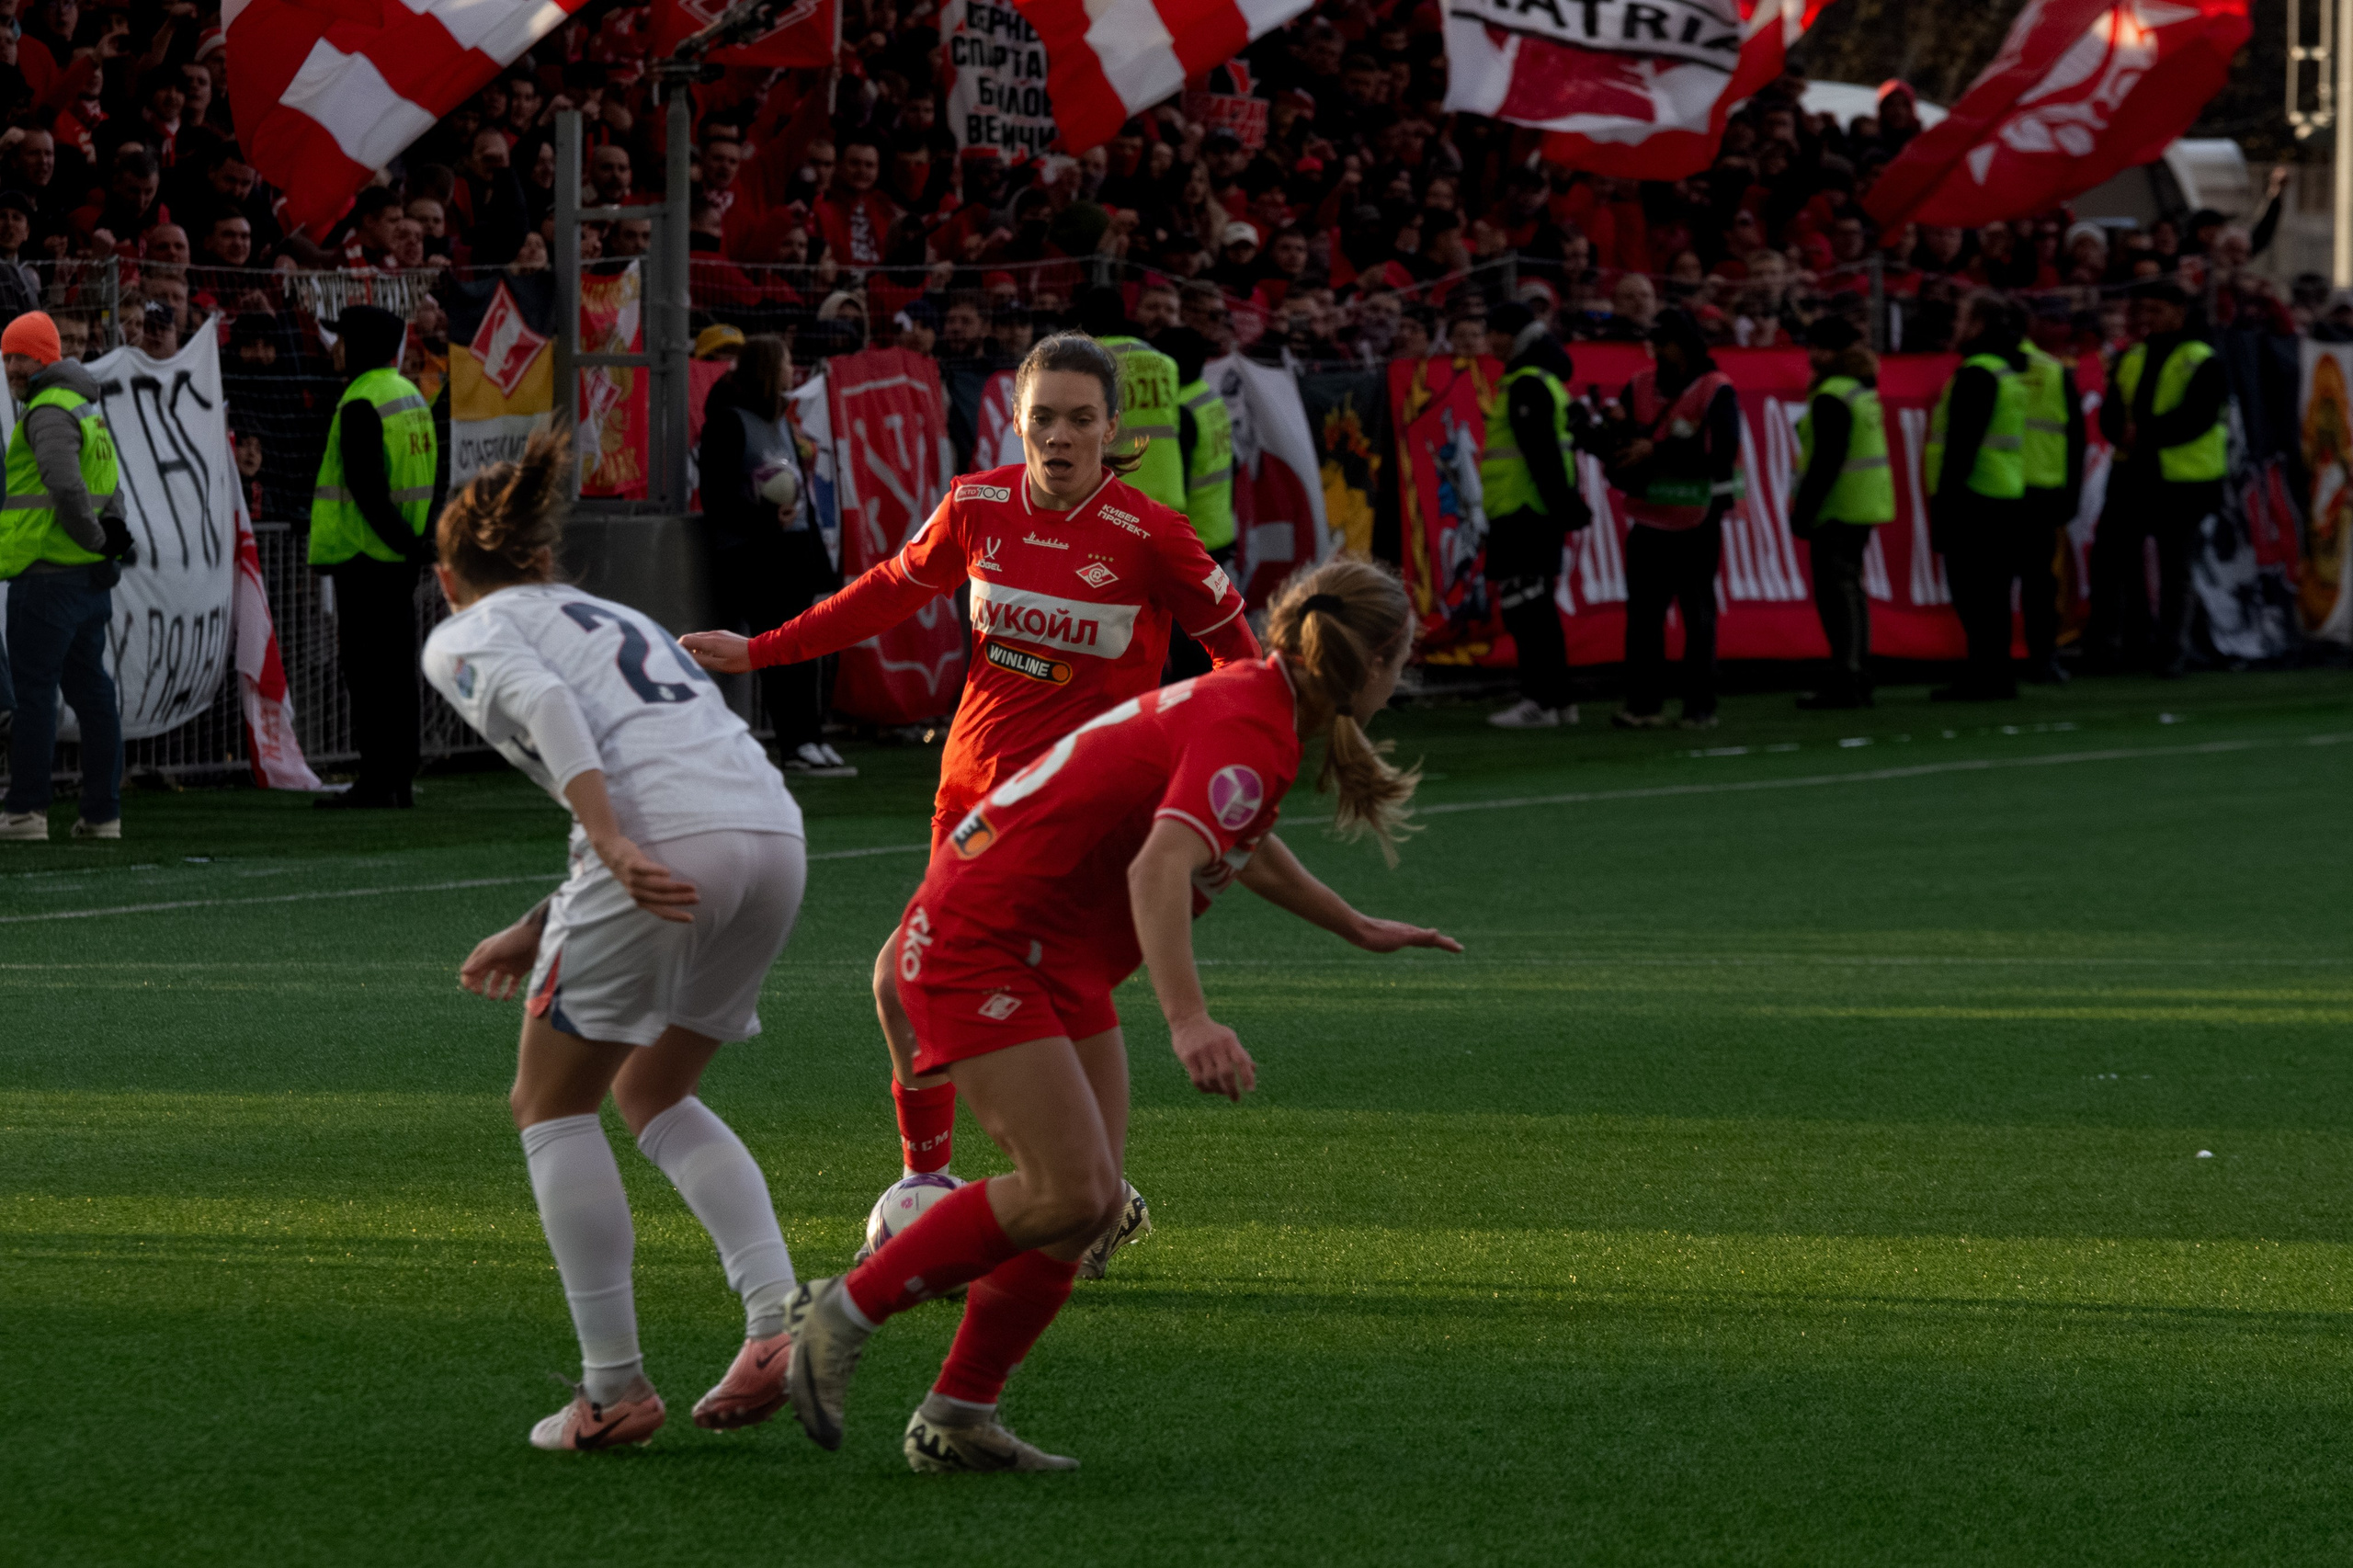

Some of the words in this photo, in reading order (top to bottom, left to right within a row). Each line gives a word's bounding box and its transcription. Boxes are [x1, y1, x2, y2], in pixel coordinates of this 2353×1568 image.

[977, 486, 1009, 501] 100
[1097, 510, 1151, 540] ПРОТЕКТ
[1101, 503, 1141, 524] КИБЕР
[990, 644, 1051, 678] WINLINE
